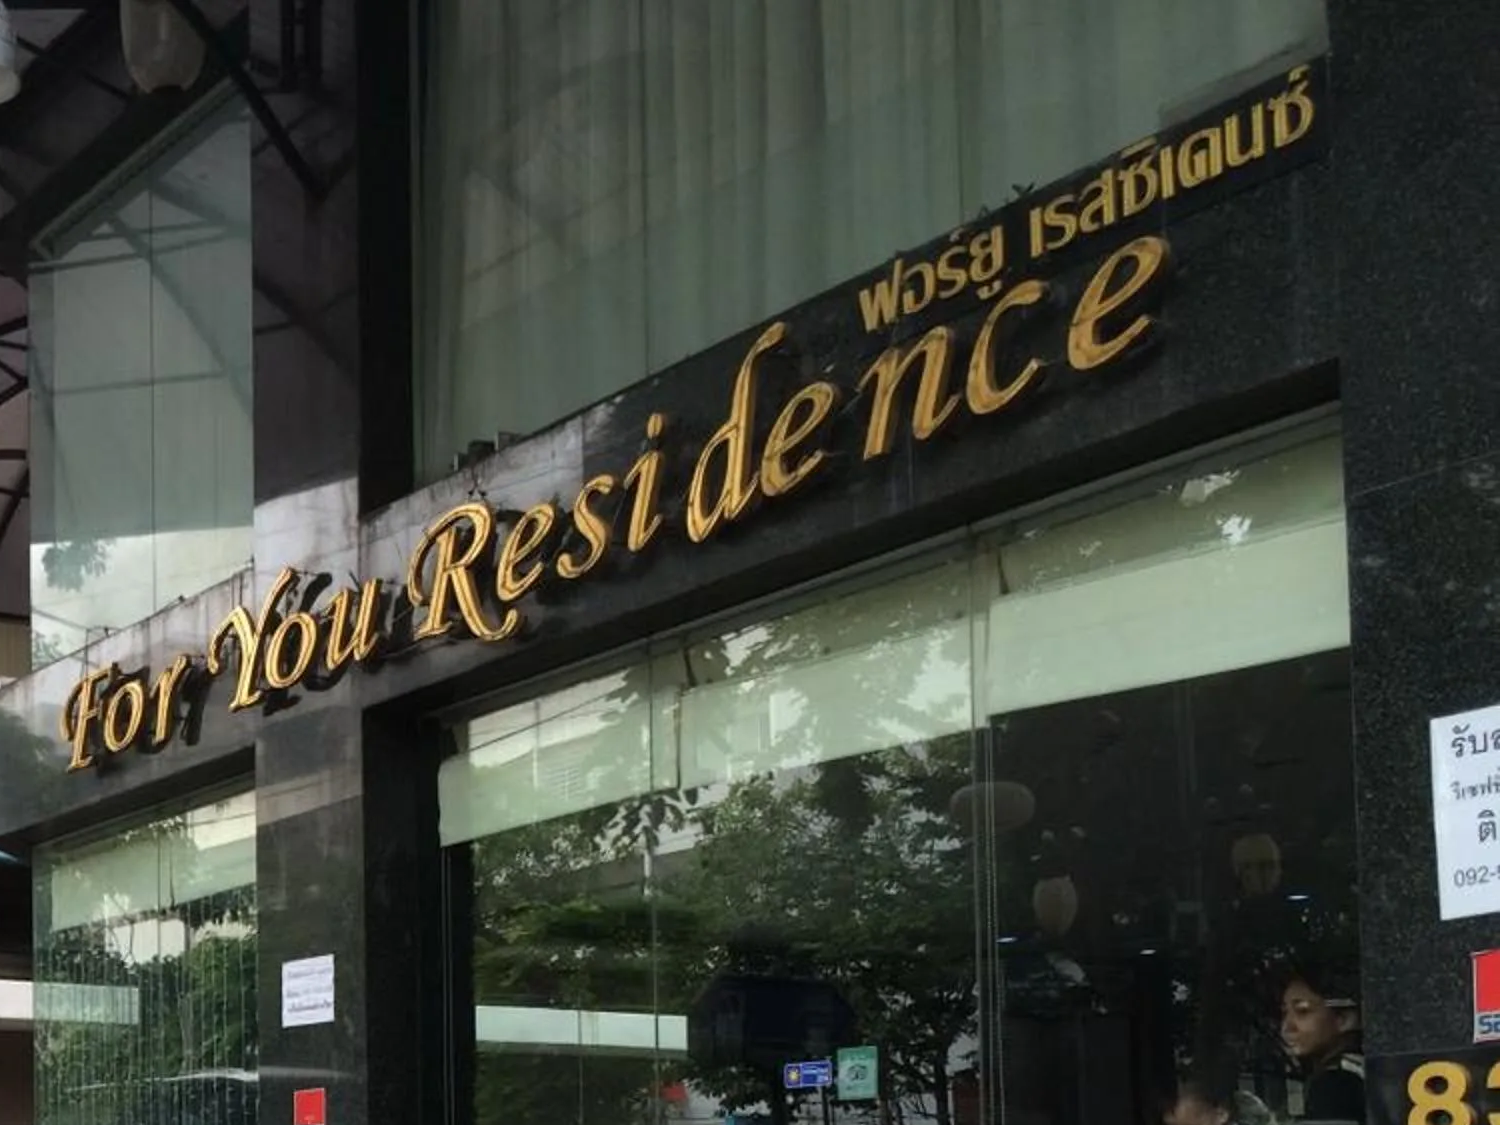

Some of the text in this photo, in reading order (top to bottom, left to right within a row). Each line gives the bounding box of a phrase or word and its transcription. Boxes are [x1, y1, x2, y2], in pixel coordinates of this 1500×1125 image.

[60, 233, 1172, 774] For You Residence
[1453, 864, 1500, 889] 092-
